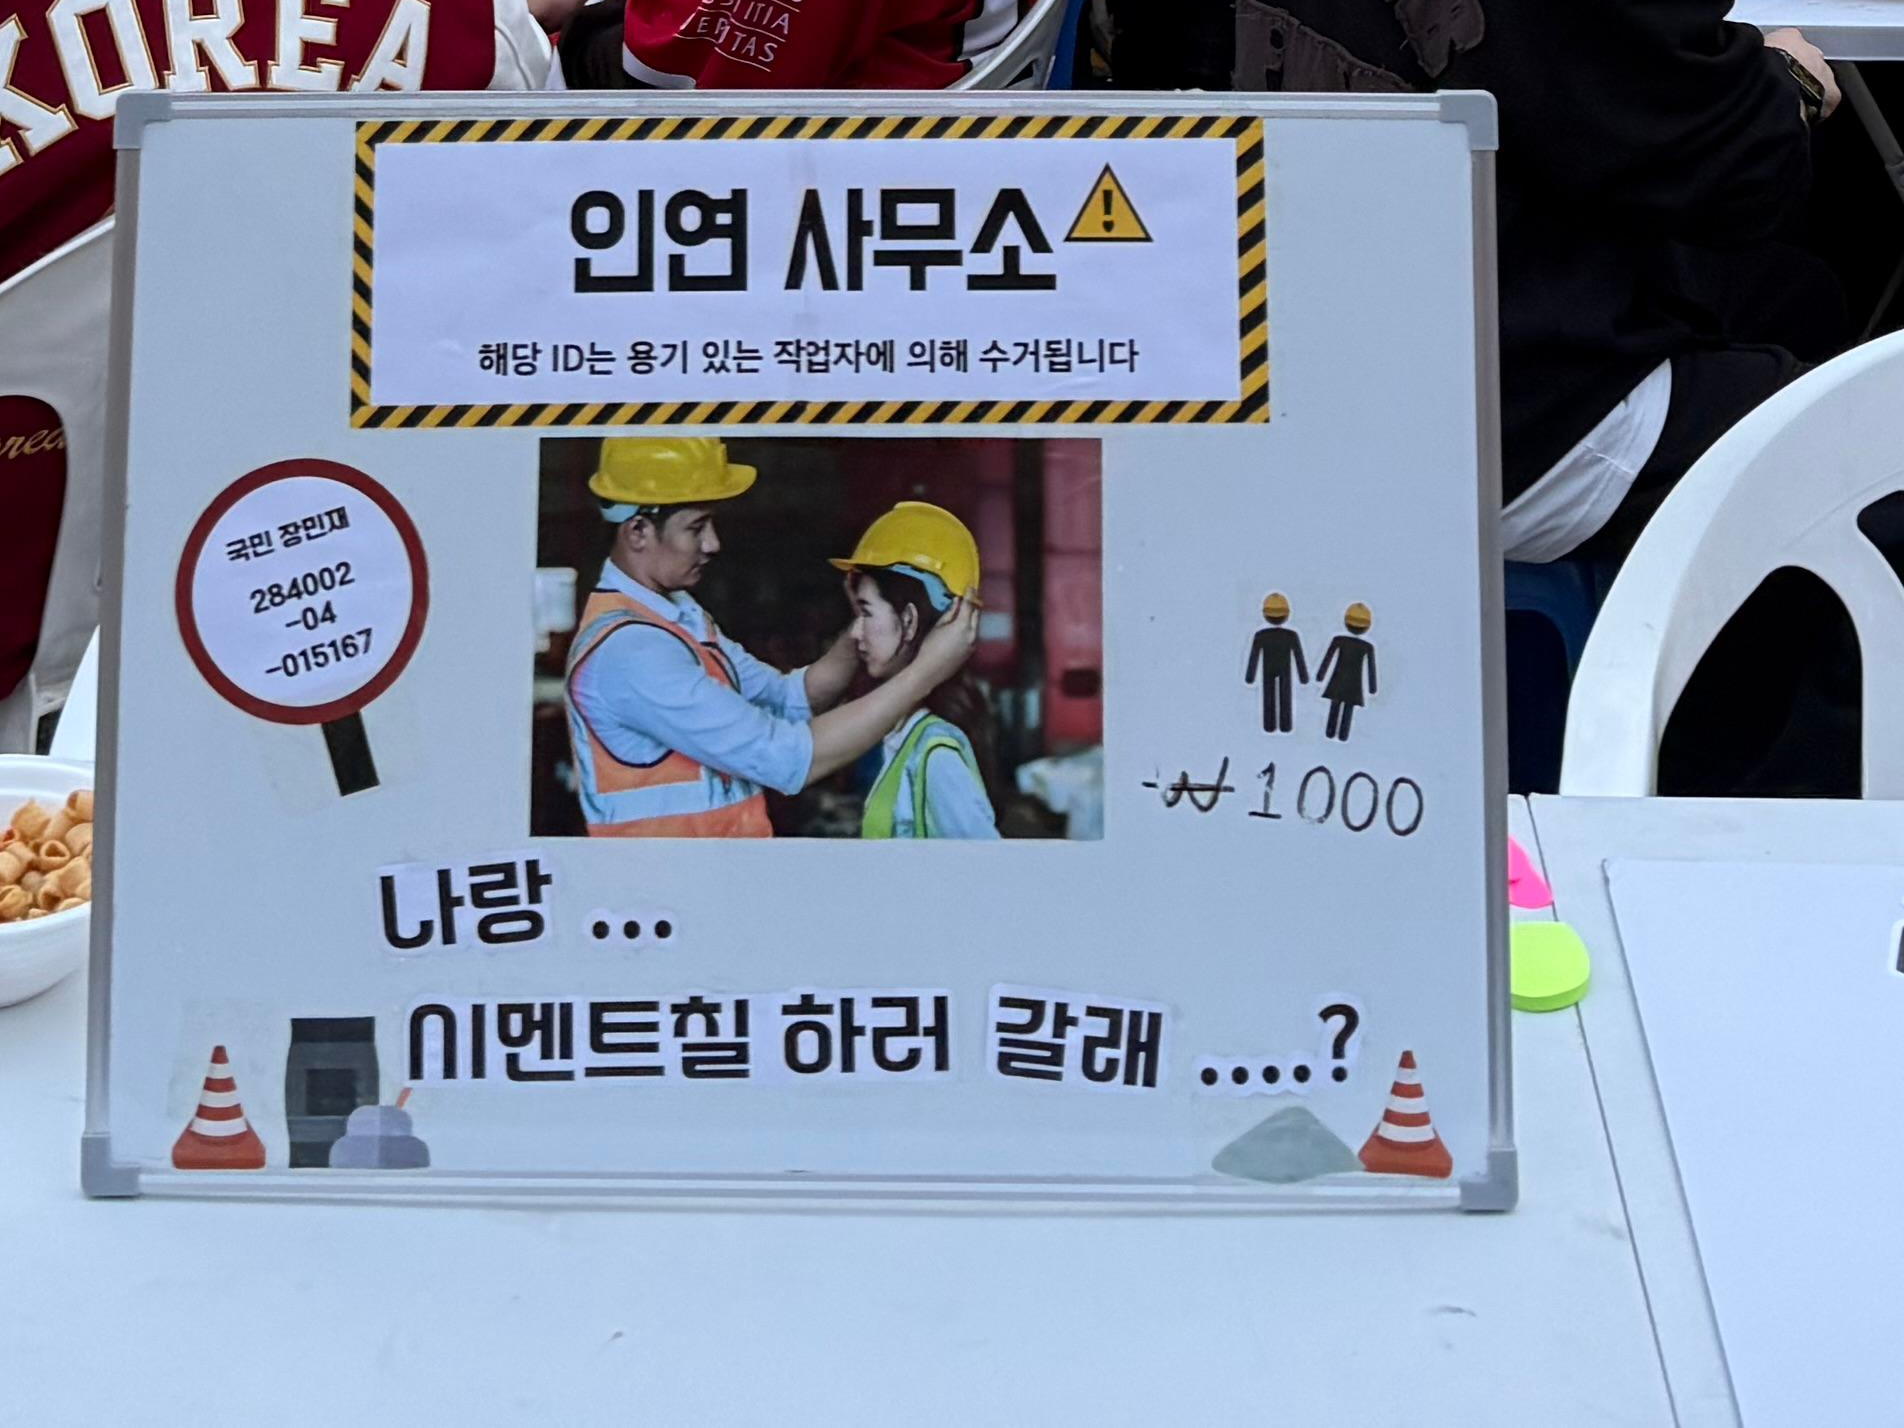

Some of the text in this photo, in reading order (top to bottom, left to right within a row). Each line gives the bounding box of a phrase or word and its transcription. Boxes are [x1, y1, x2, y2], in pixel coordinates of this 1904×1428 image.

[570, 188, 1057, 294] 인연 사무소
[478, 338, 1140, 377] 해당 ID는 용기 있는 작업자에 의해 수거됩니다
[225, 505, 350, 562] 국민 장민재
[249, 561, 355, 614] 284002
[285, 600, 338, 631] -04
[265, 627, 373, 677] -015167
[379, 859, 553, 950] 나랑
[409, 994, 751, 1082] 시멘트칠
[781, 993, 949, 1076] 하러
[995, 995, 1163, 1089] 갈래
